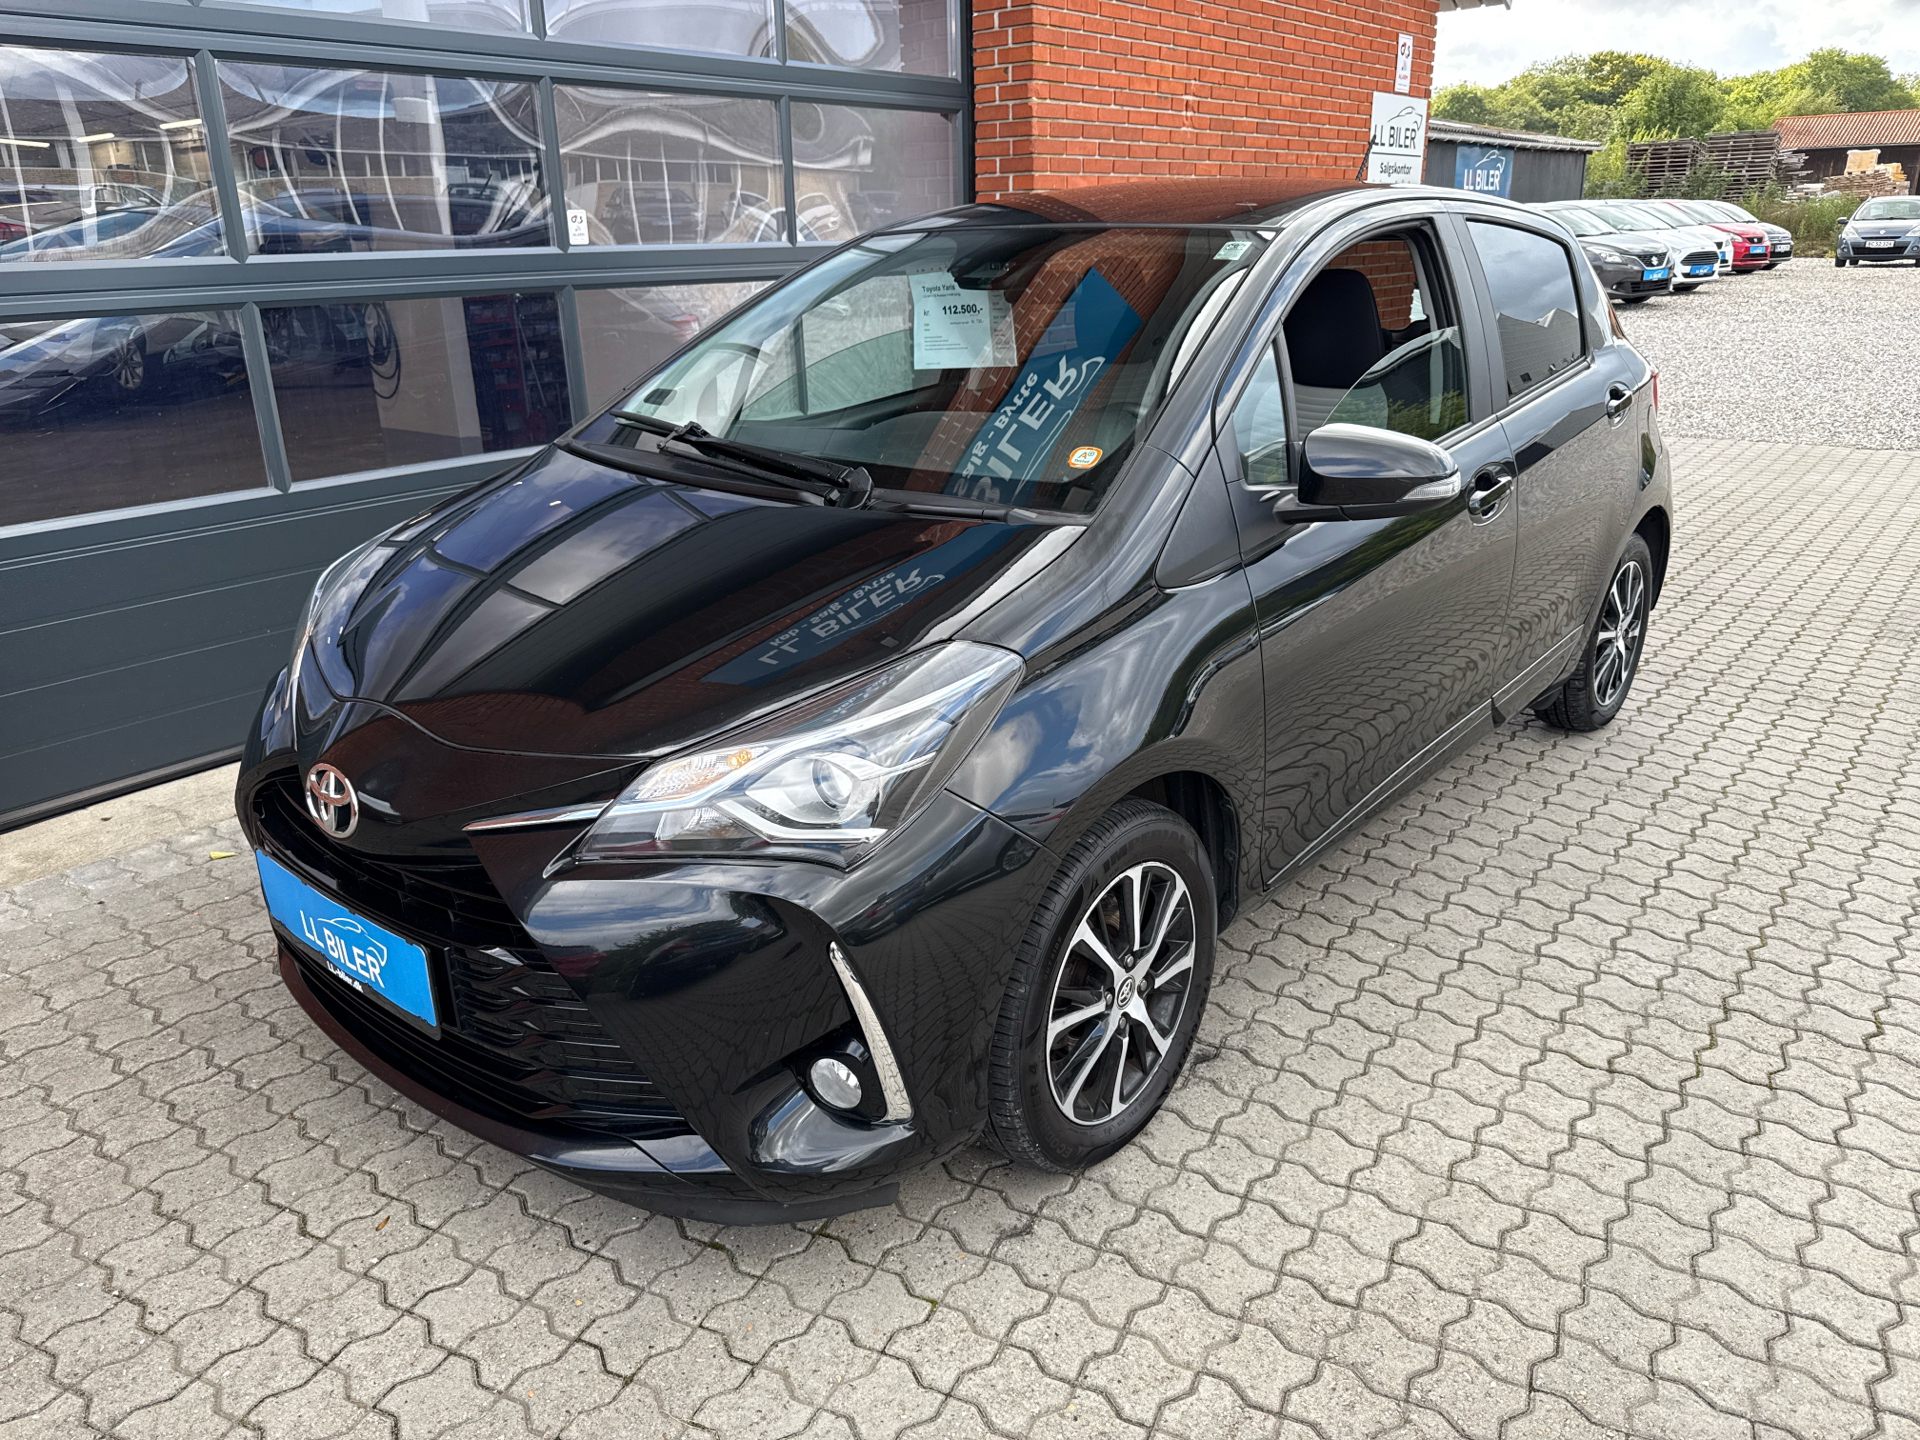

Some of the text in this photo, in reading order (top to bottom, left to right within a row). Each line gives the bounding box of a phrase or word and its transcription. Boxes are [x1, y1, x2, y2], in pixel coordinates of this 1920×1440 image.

[1373, 123, 1417, 149] LL BILER
[1379, 161, 1412, 177] Salgskontor
[1463, 169, 1500, 191] LL BILER
[921, 283, 956, 293] Toyota Yaris
[942, 303, 984, 315] 112.500,-
[299, 909, 386, 989] LL BILER
